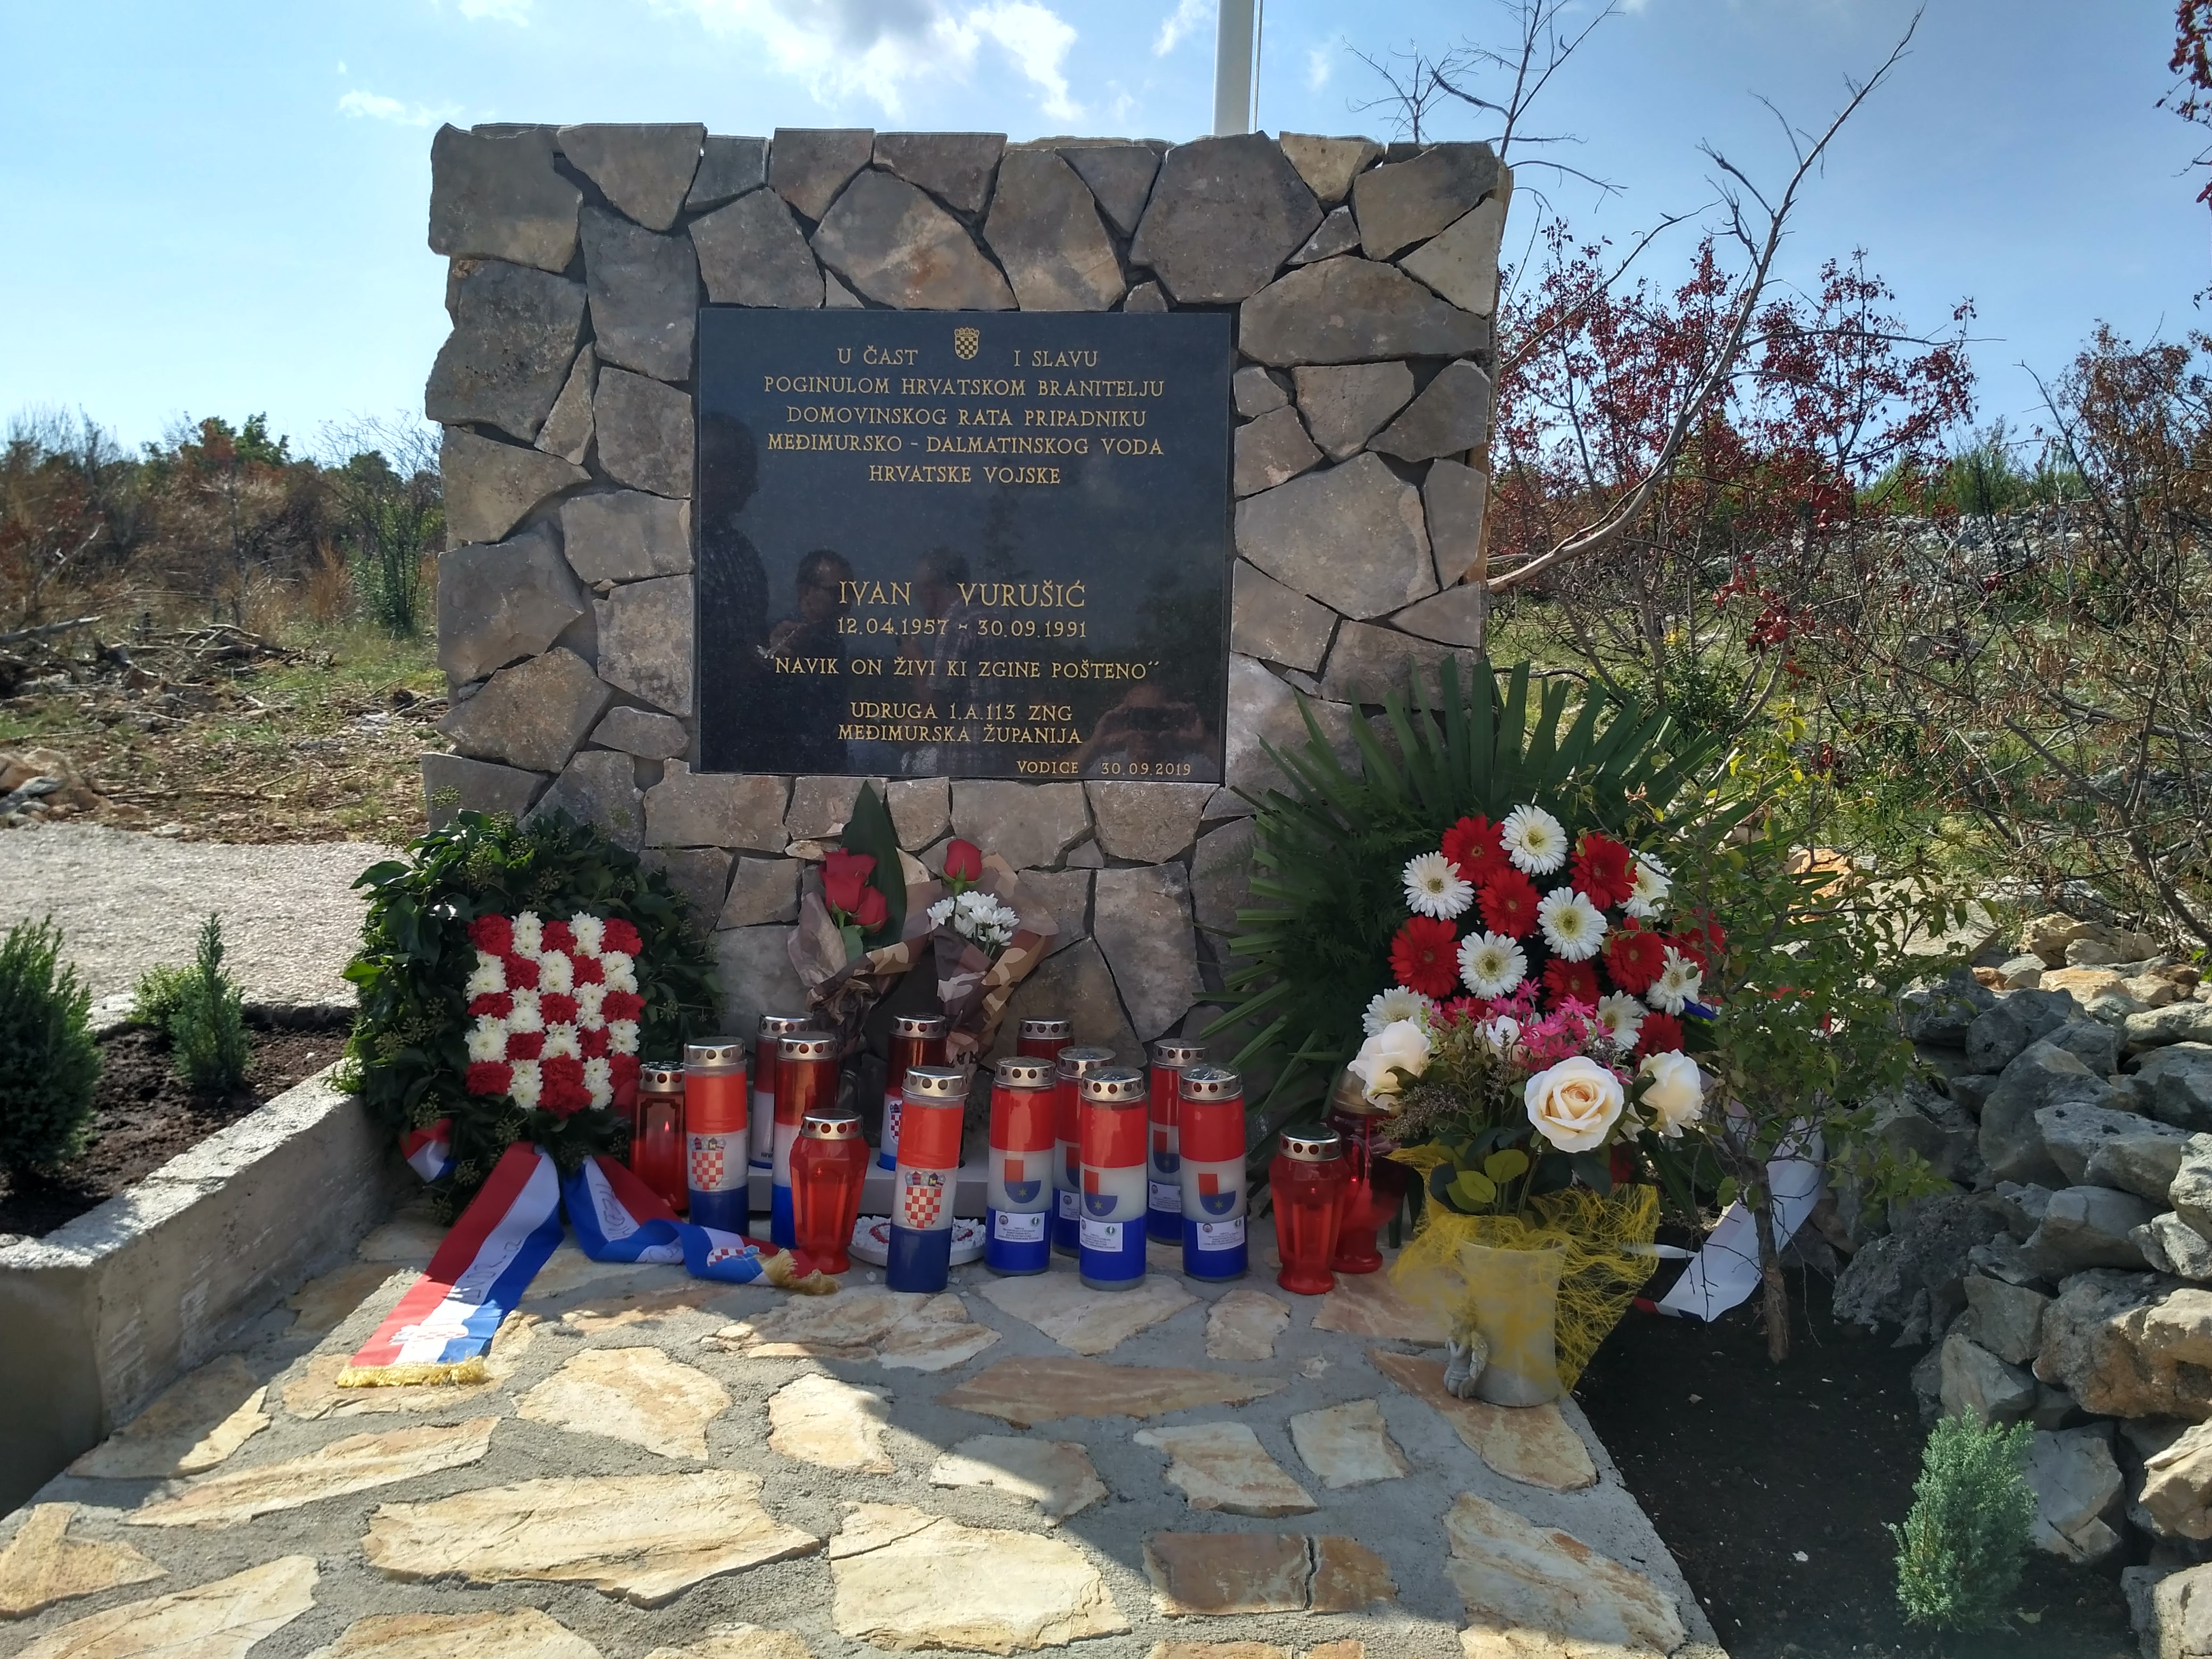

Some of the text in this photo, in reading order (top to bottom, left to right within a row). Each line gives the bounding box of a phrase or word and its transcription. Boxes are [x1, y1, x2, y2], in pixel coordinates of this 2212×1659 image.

[837, 345, 1098, 367] U ČAST I SLAVU
[764, 376, 1164, 397] POGINULOM HRVATSKOM BRANITELJU
[786, 406, 1146, 428] DOMOVINSKOG RATA PRIPADNIKU
[767, 433, 902, 452] MEĐIMURSKO
[926, 435, 1088, 454] DALMATINSKOG
[1100, 438, 1164, 455] VODA
[869, 465, 1061, 484] HRVATSKE VOJSKE
[839, 579, 1085, 607] IVAN VURUŠIĆ
[837, 616, 950, 635] 12.04.1957
[977, 619, 1086, 638] 30.09.1991
[851, 659, 882, 675] ON
[893, 656, 936, 676] ŽIVI
[946, 660, 967, 677] KI
[978, 661, 1041, 678] ZGINE
[850, 701, 1073, 722] UDRUGA 1.A.113 ZNG
[837, 723, 1083, 744] MEĐIMURSKA ŽUPANIJA
[1016, 760, 1191, 776] VODICE 30.09.2019
